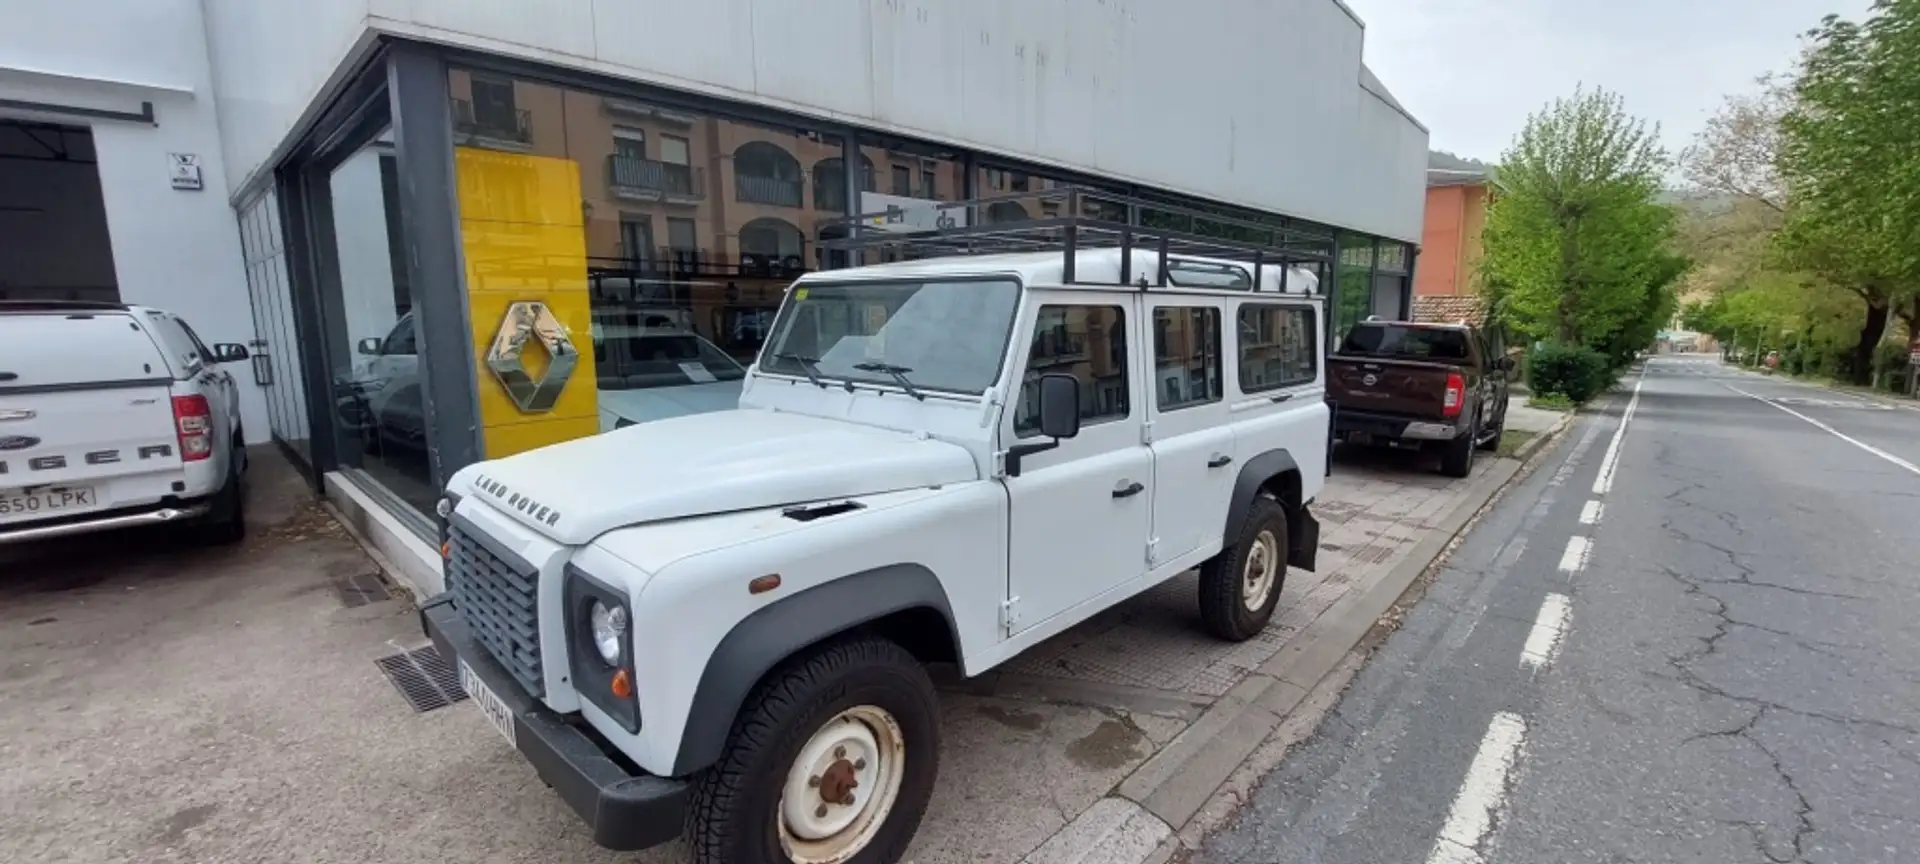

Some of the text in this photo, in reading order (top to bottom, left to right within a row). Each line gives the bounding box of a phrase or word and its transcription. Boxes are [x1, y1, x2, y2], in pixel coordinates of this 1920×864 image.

[47, 491, 88, 508] LPK
[475, 474, 560, 526] LAND ROVER
